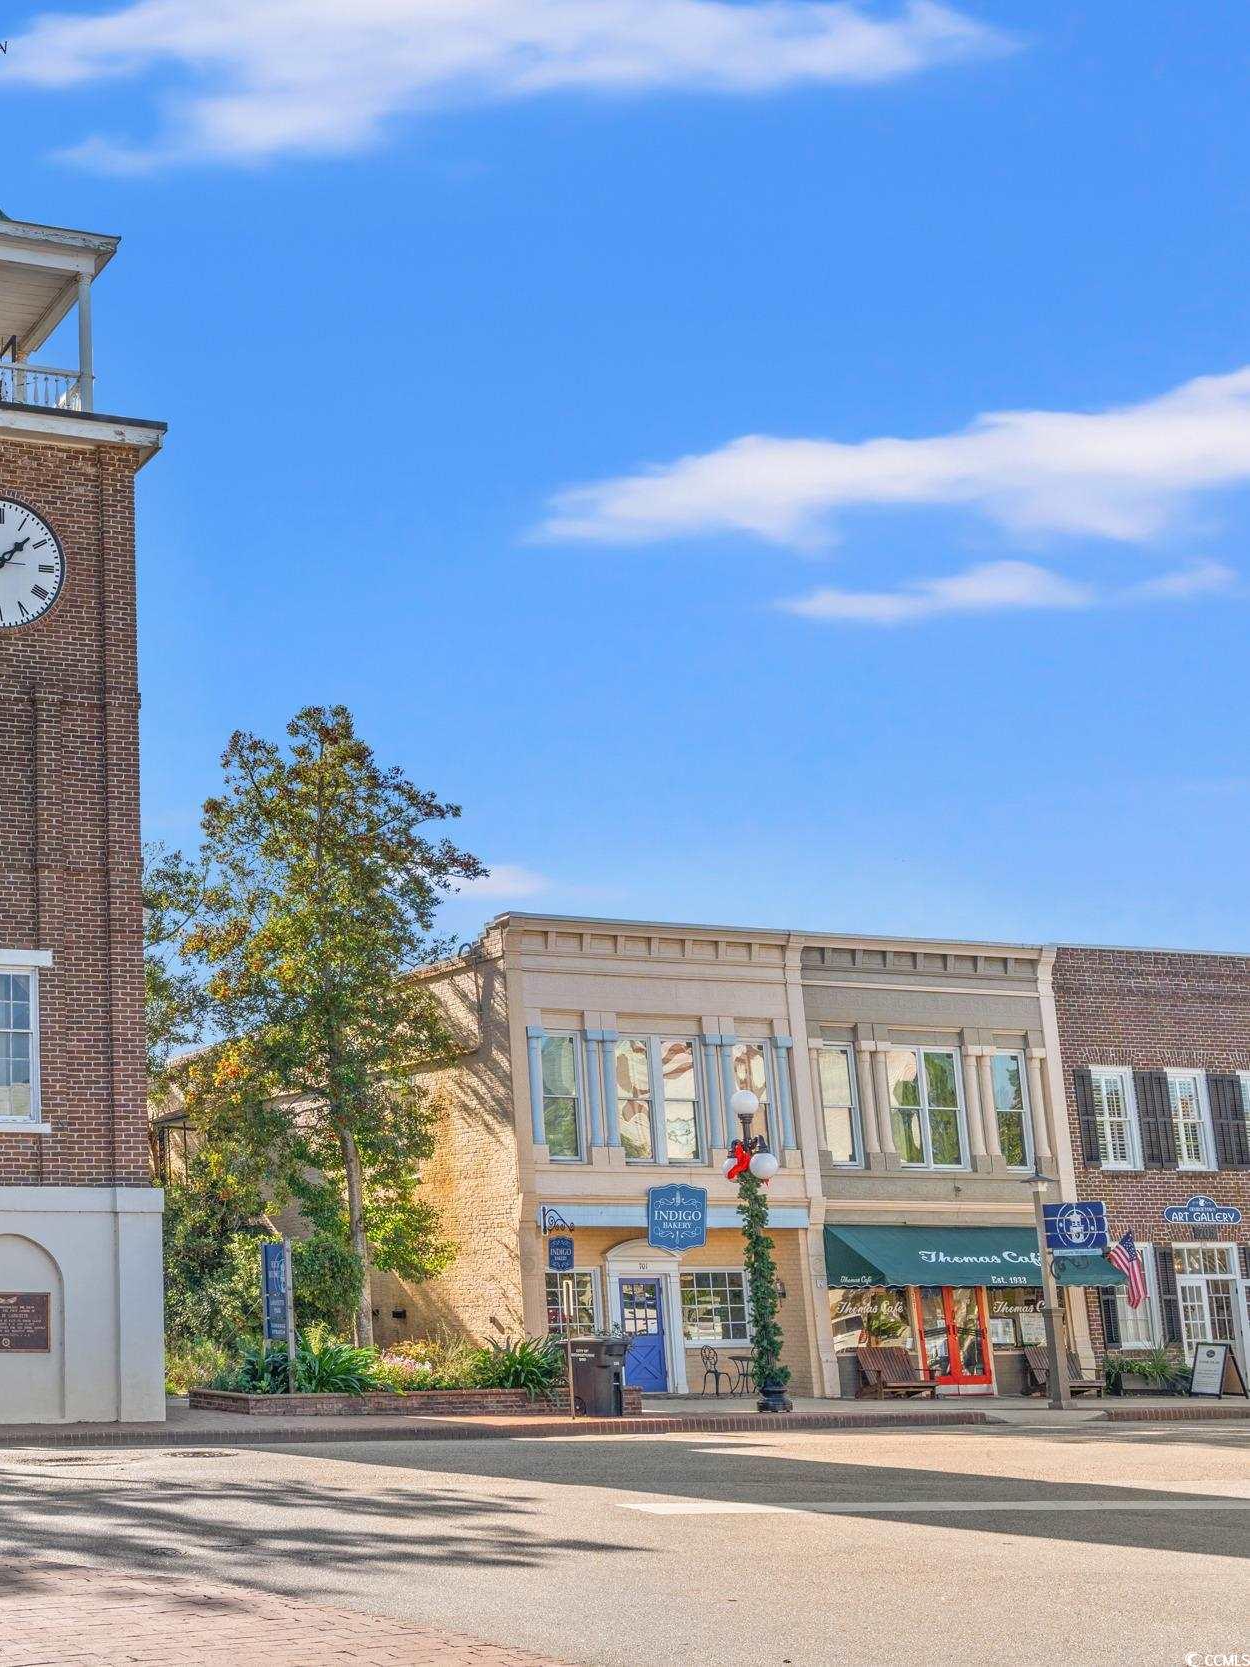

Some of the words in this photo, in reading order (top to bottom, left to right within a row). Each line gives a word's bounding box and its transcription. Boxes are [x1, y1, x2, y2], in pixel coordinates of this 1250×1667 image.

[38, 564, 55, 573] III
[654, 1210, 702, 1221] INDIGO
[1171, 1212, 1190, 1222] ART
[1193, 1212, 1235, 1222] GALLERY
[550, 1248, 572, 1256] INDIGO
[918, 1251, 1001, 1264] Thomas
[991, 1276, 1008, 1284] Est.
[837, 1301, 878, 1314] Thomas
[993, 1301, 1034, 1313] Thomas
